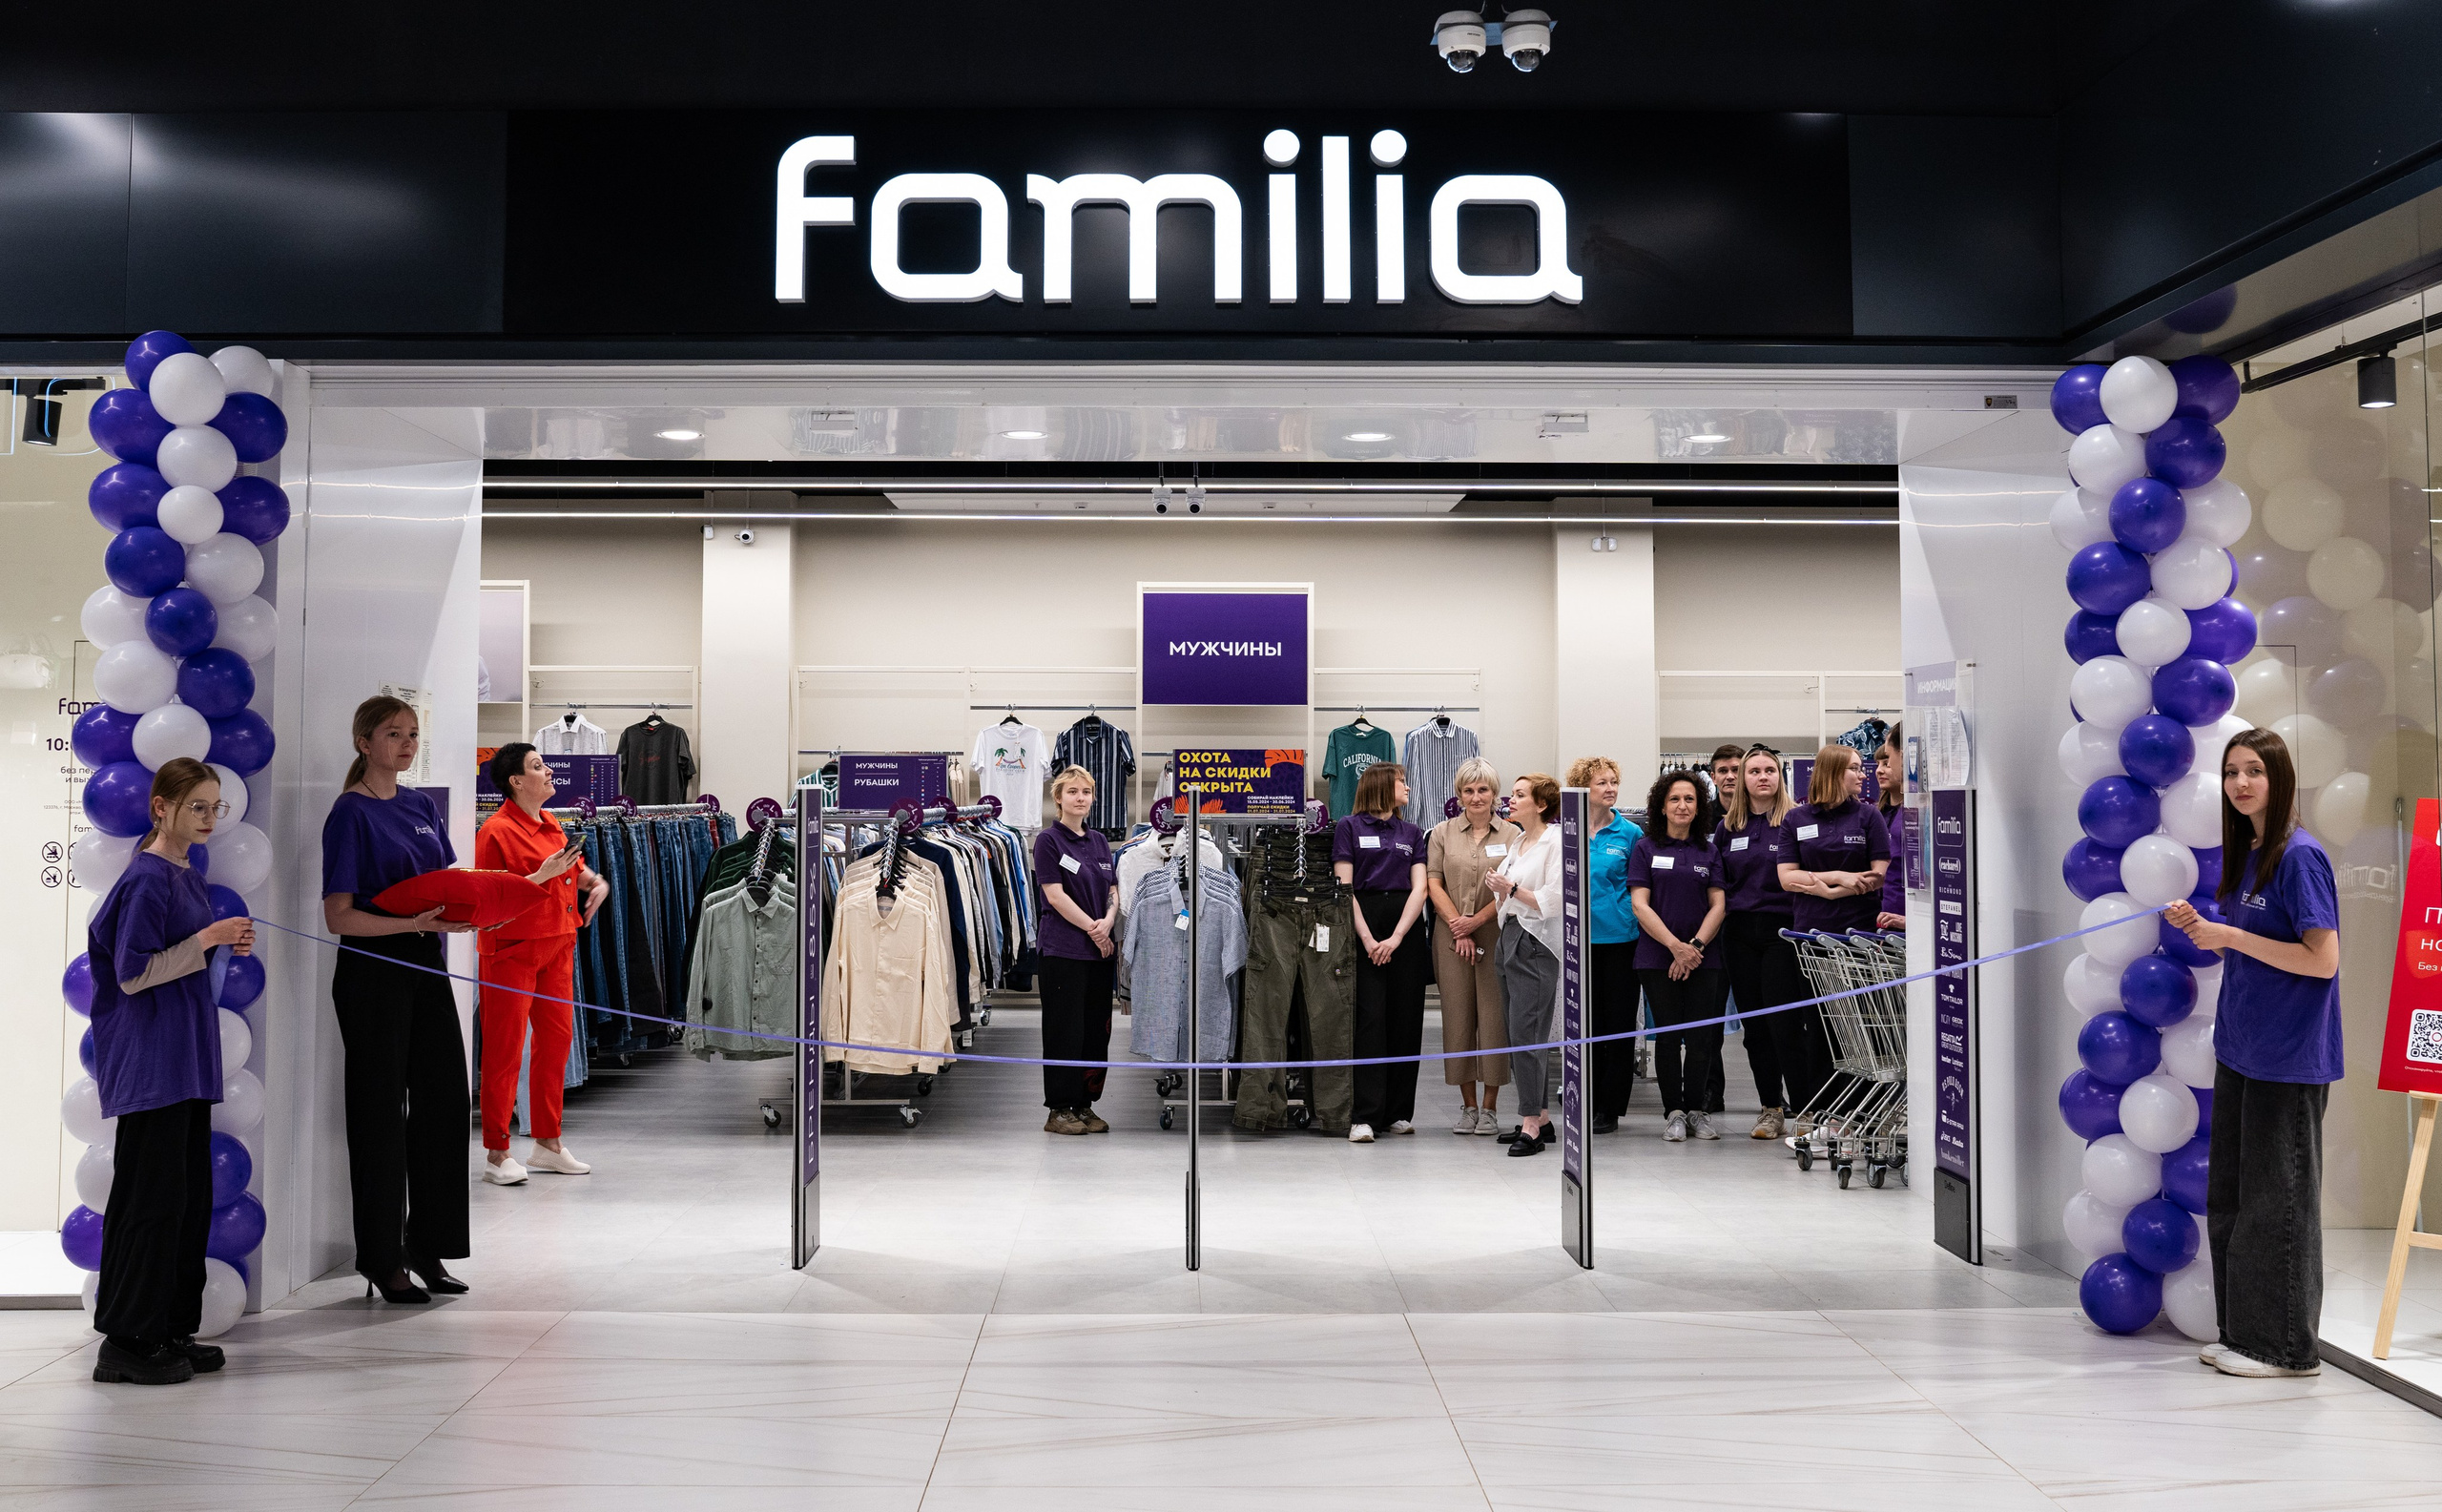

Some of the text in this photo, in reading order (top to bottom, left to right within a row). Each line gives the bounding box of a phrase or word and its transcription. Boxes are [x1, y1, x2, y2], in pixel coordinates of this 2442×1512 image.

[775, 129, 1584, 305] familia
[1169, 641, 1282, 656] МУЖЧИНЫ
[47, 738, 73, 751] 10:
[1179, 752, 1231, 763] ОХОТА
[1179, 767, 1272, 780] НА СКИДКИ
[74, 824, 95, 833] fam
[1937, 817, 1962, 835] familia
[808, 862, 817, 958] 85%
[1940, 903, 1961, 913] STEFANEL
[2418, 961, 2438, 972] Без
[808, 995, 817, 1165] БРЕНДЫ
